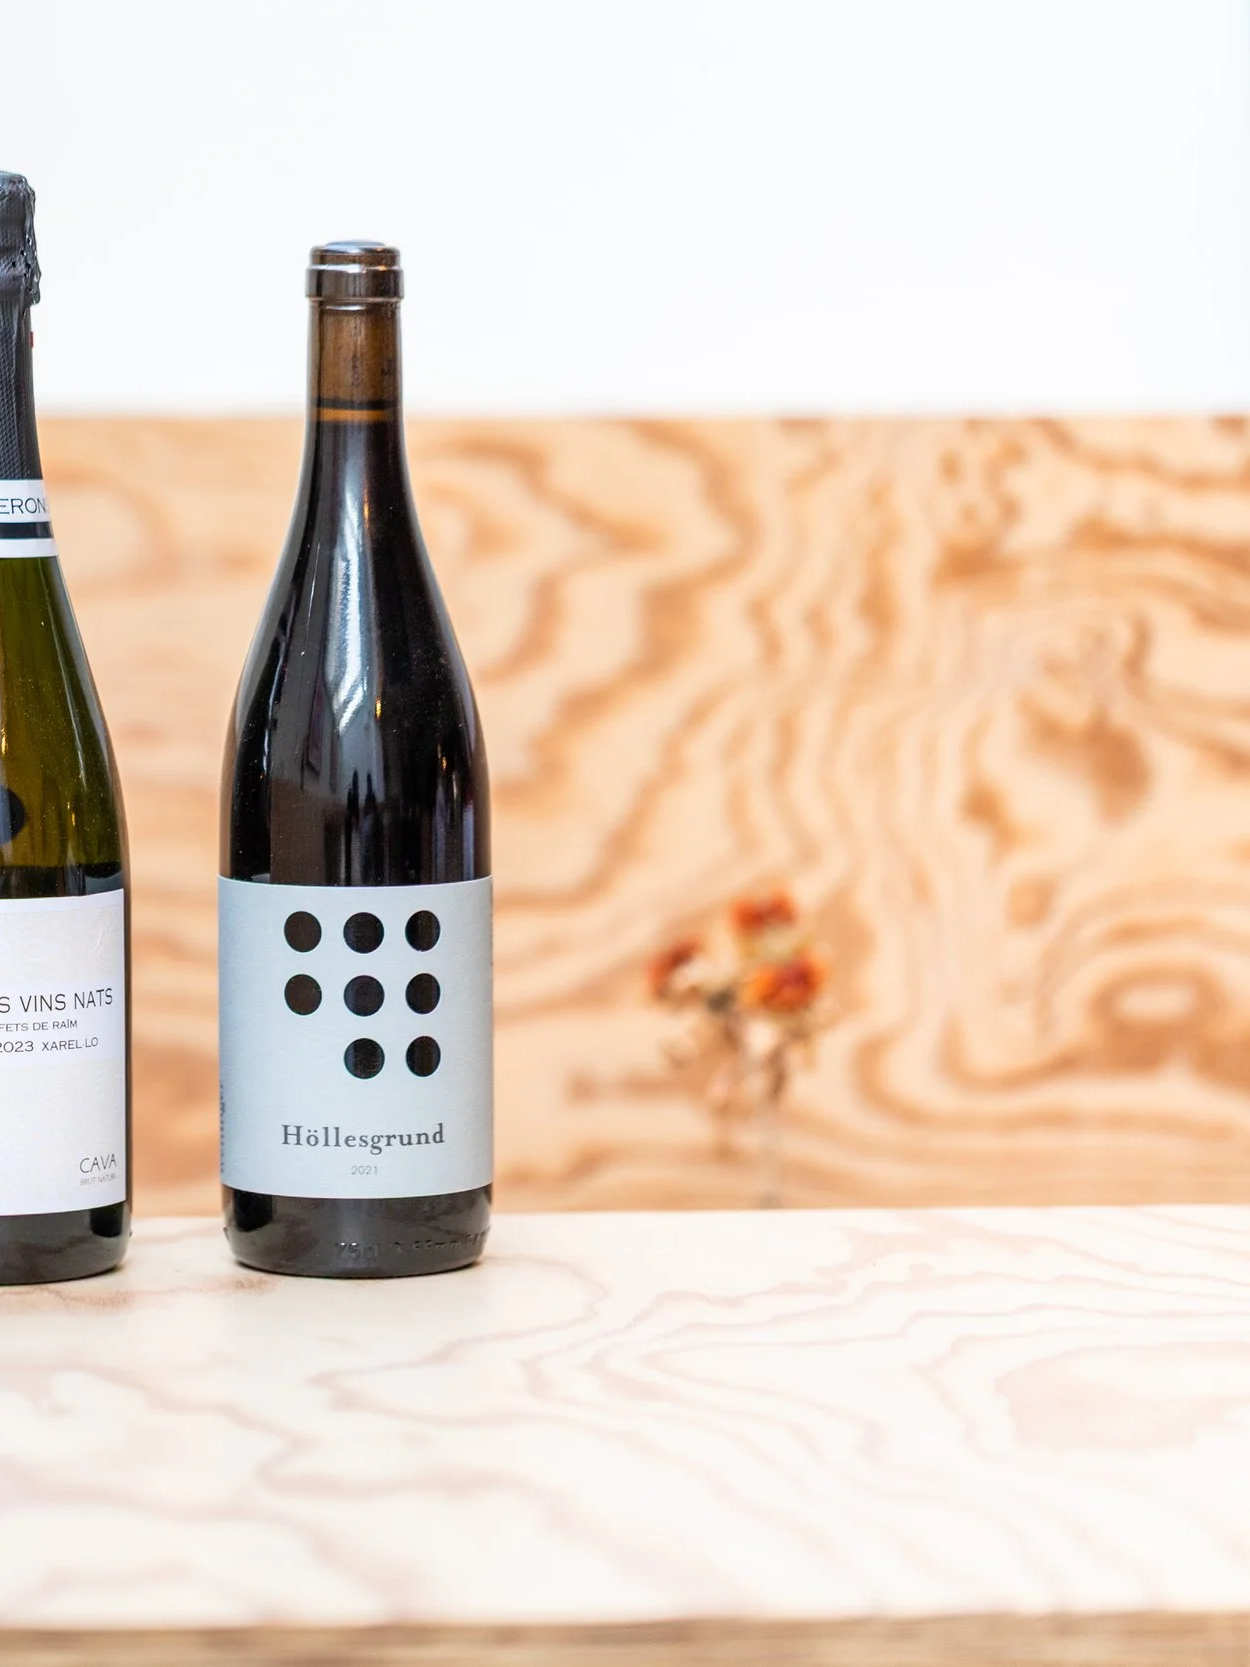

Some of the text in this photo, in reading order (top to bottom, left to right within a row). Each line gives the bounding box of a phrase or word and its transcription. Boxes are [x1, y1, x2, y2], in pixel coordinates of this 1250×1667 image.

[19, 993, 66, 1013] VINS
[74, 987, 113, 1009] NATS
[32, 1020, 49, 1031] DE
[281, 1122, 445, 1155] Höllesgrund
[79, 1153, 117, 1173] CAVA
[350, 1165, 378, 1176] 2021
